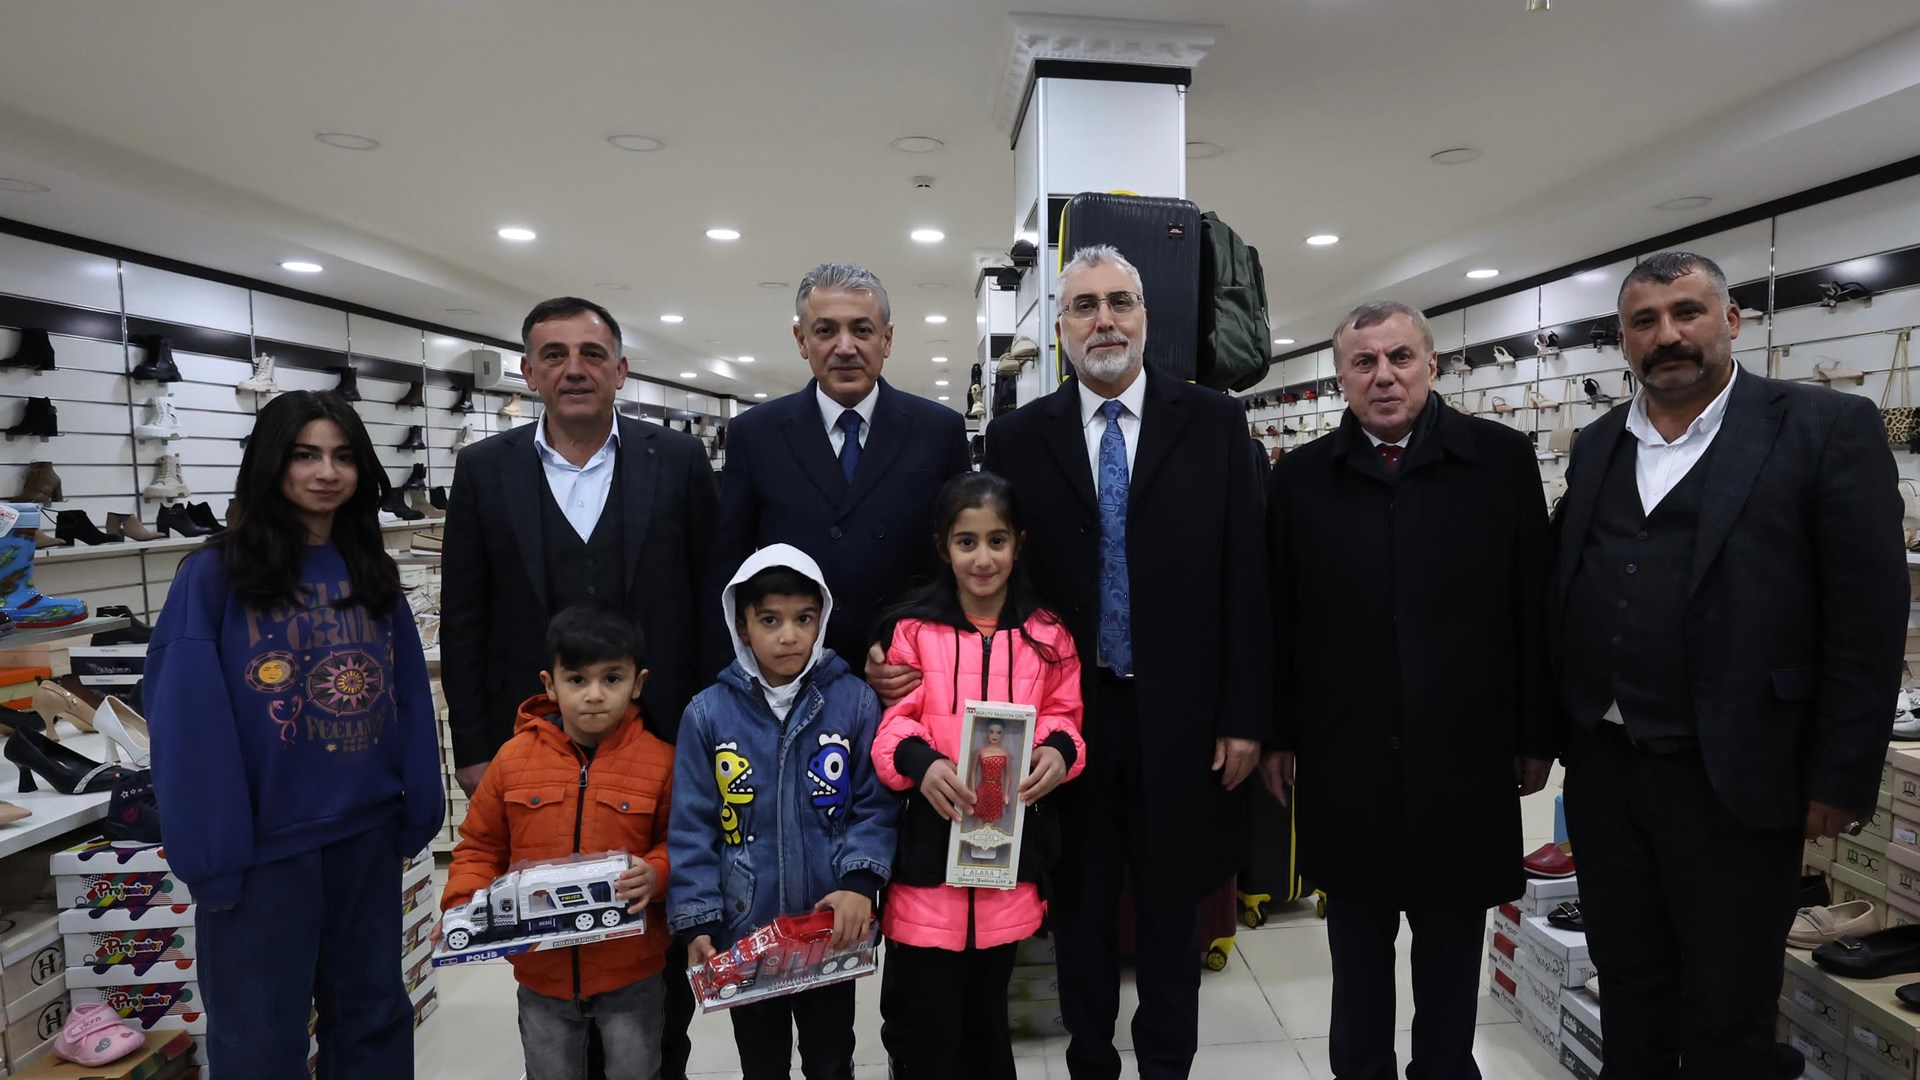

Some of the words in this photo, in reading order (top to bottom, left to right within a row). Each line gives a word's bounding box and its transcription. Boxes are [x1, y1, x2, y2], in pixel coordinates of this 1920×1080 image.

[92, 880, 153, 901] Projunior
[102, 937, 164, 957] Projunior
[109, 992, 172, 1012] Projunior
